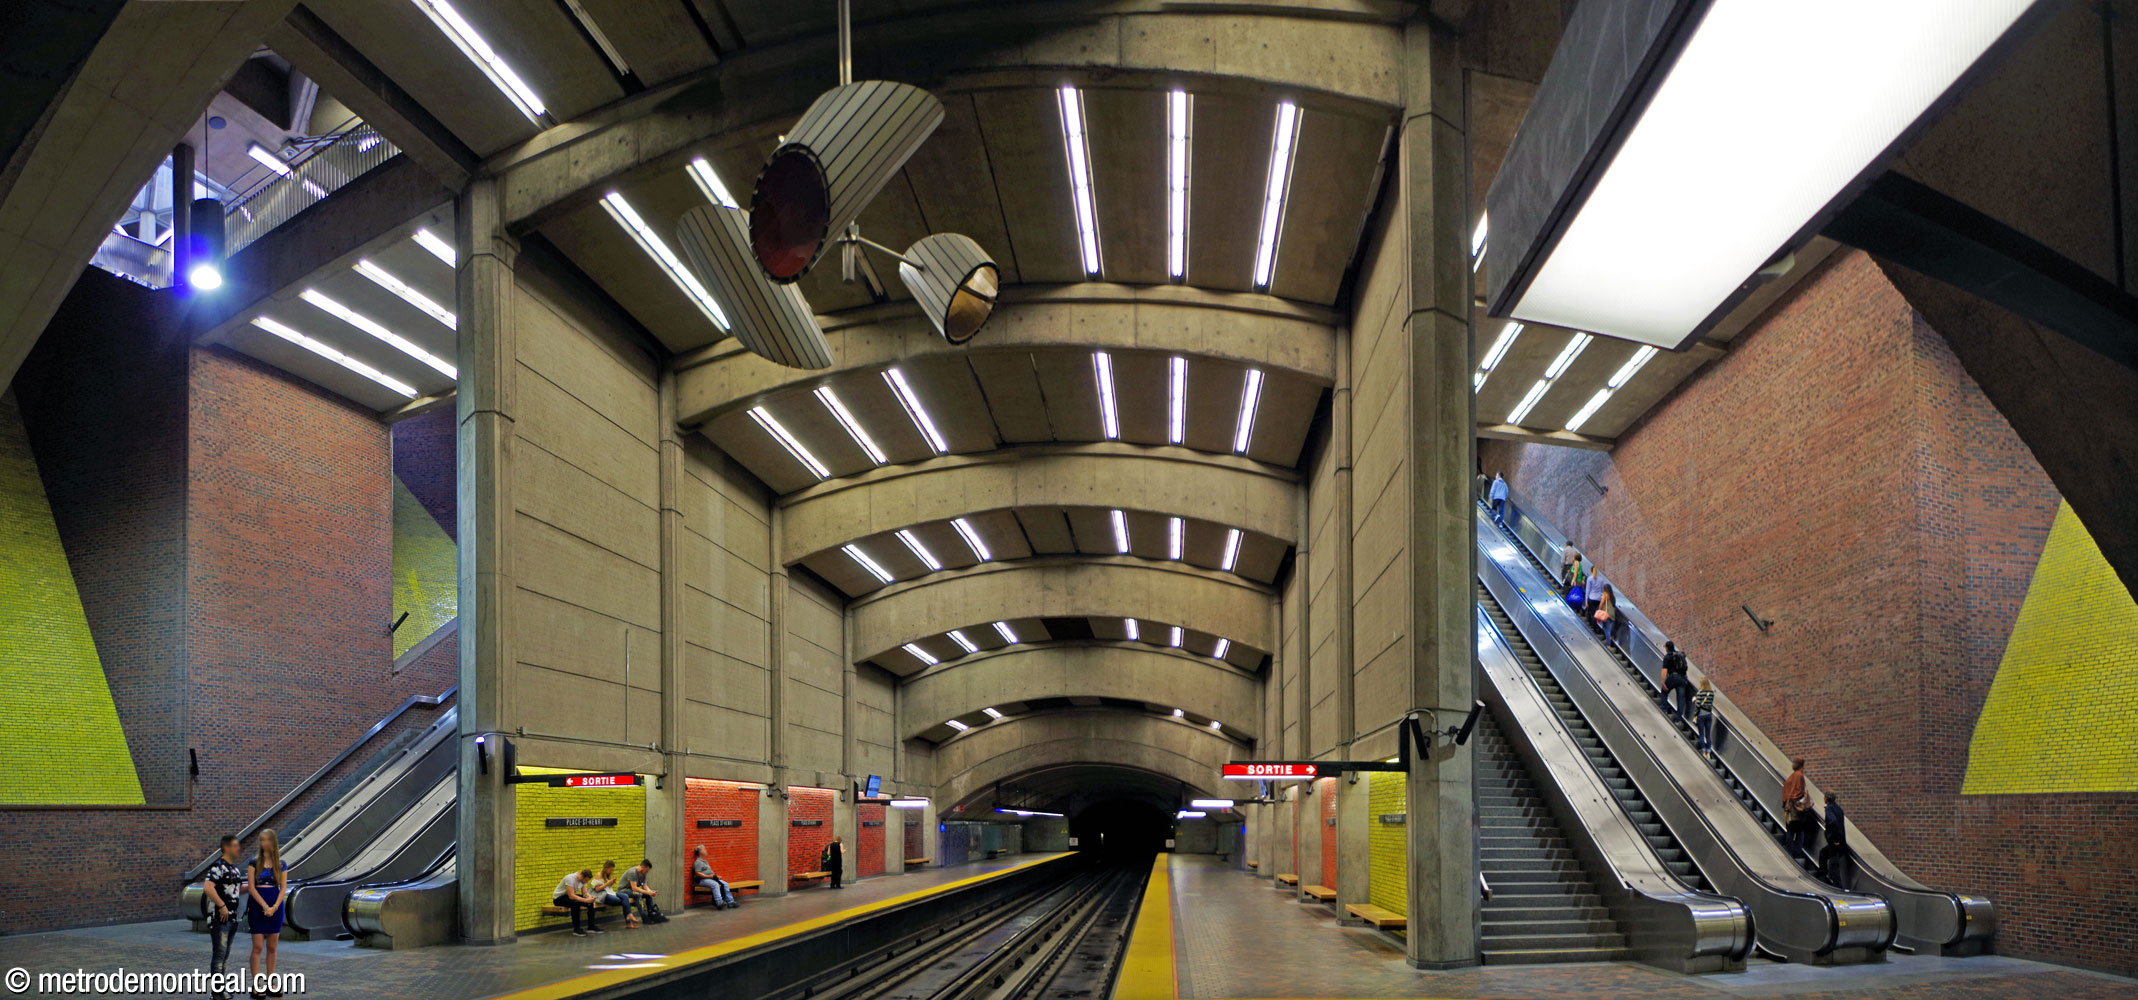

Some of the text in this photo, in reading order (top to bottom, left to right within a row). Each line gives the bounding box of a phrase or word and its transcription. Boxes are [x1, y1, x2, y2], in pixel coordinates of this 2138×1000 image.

[1247, 764, 1293, 774] SORTIE
[582, 776, 616, 785] SORTIE
[566, 818, 581, 826] PLACE
